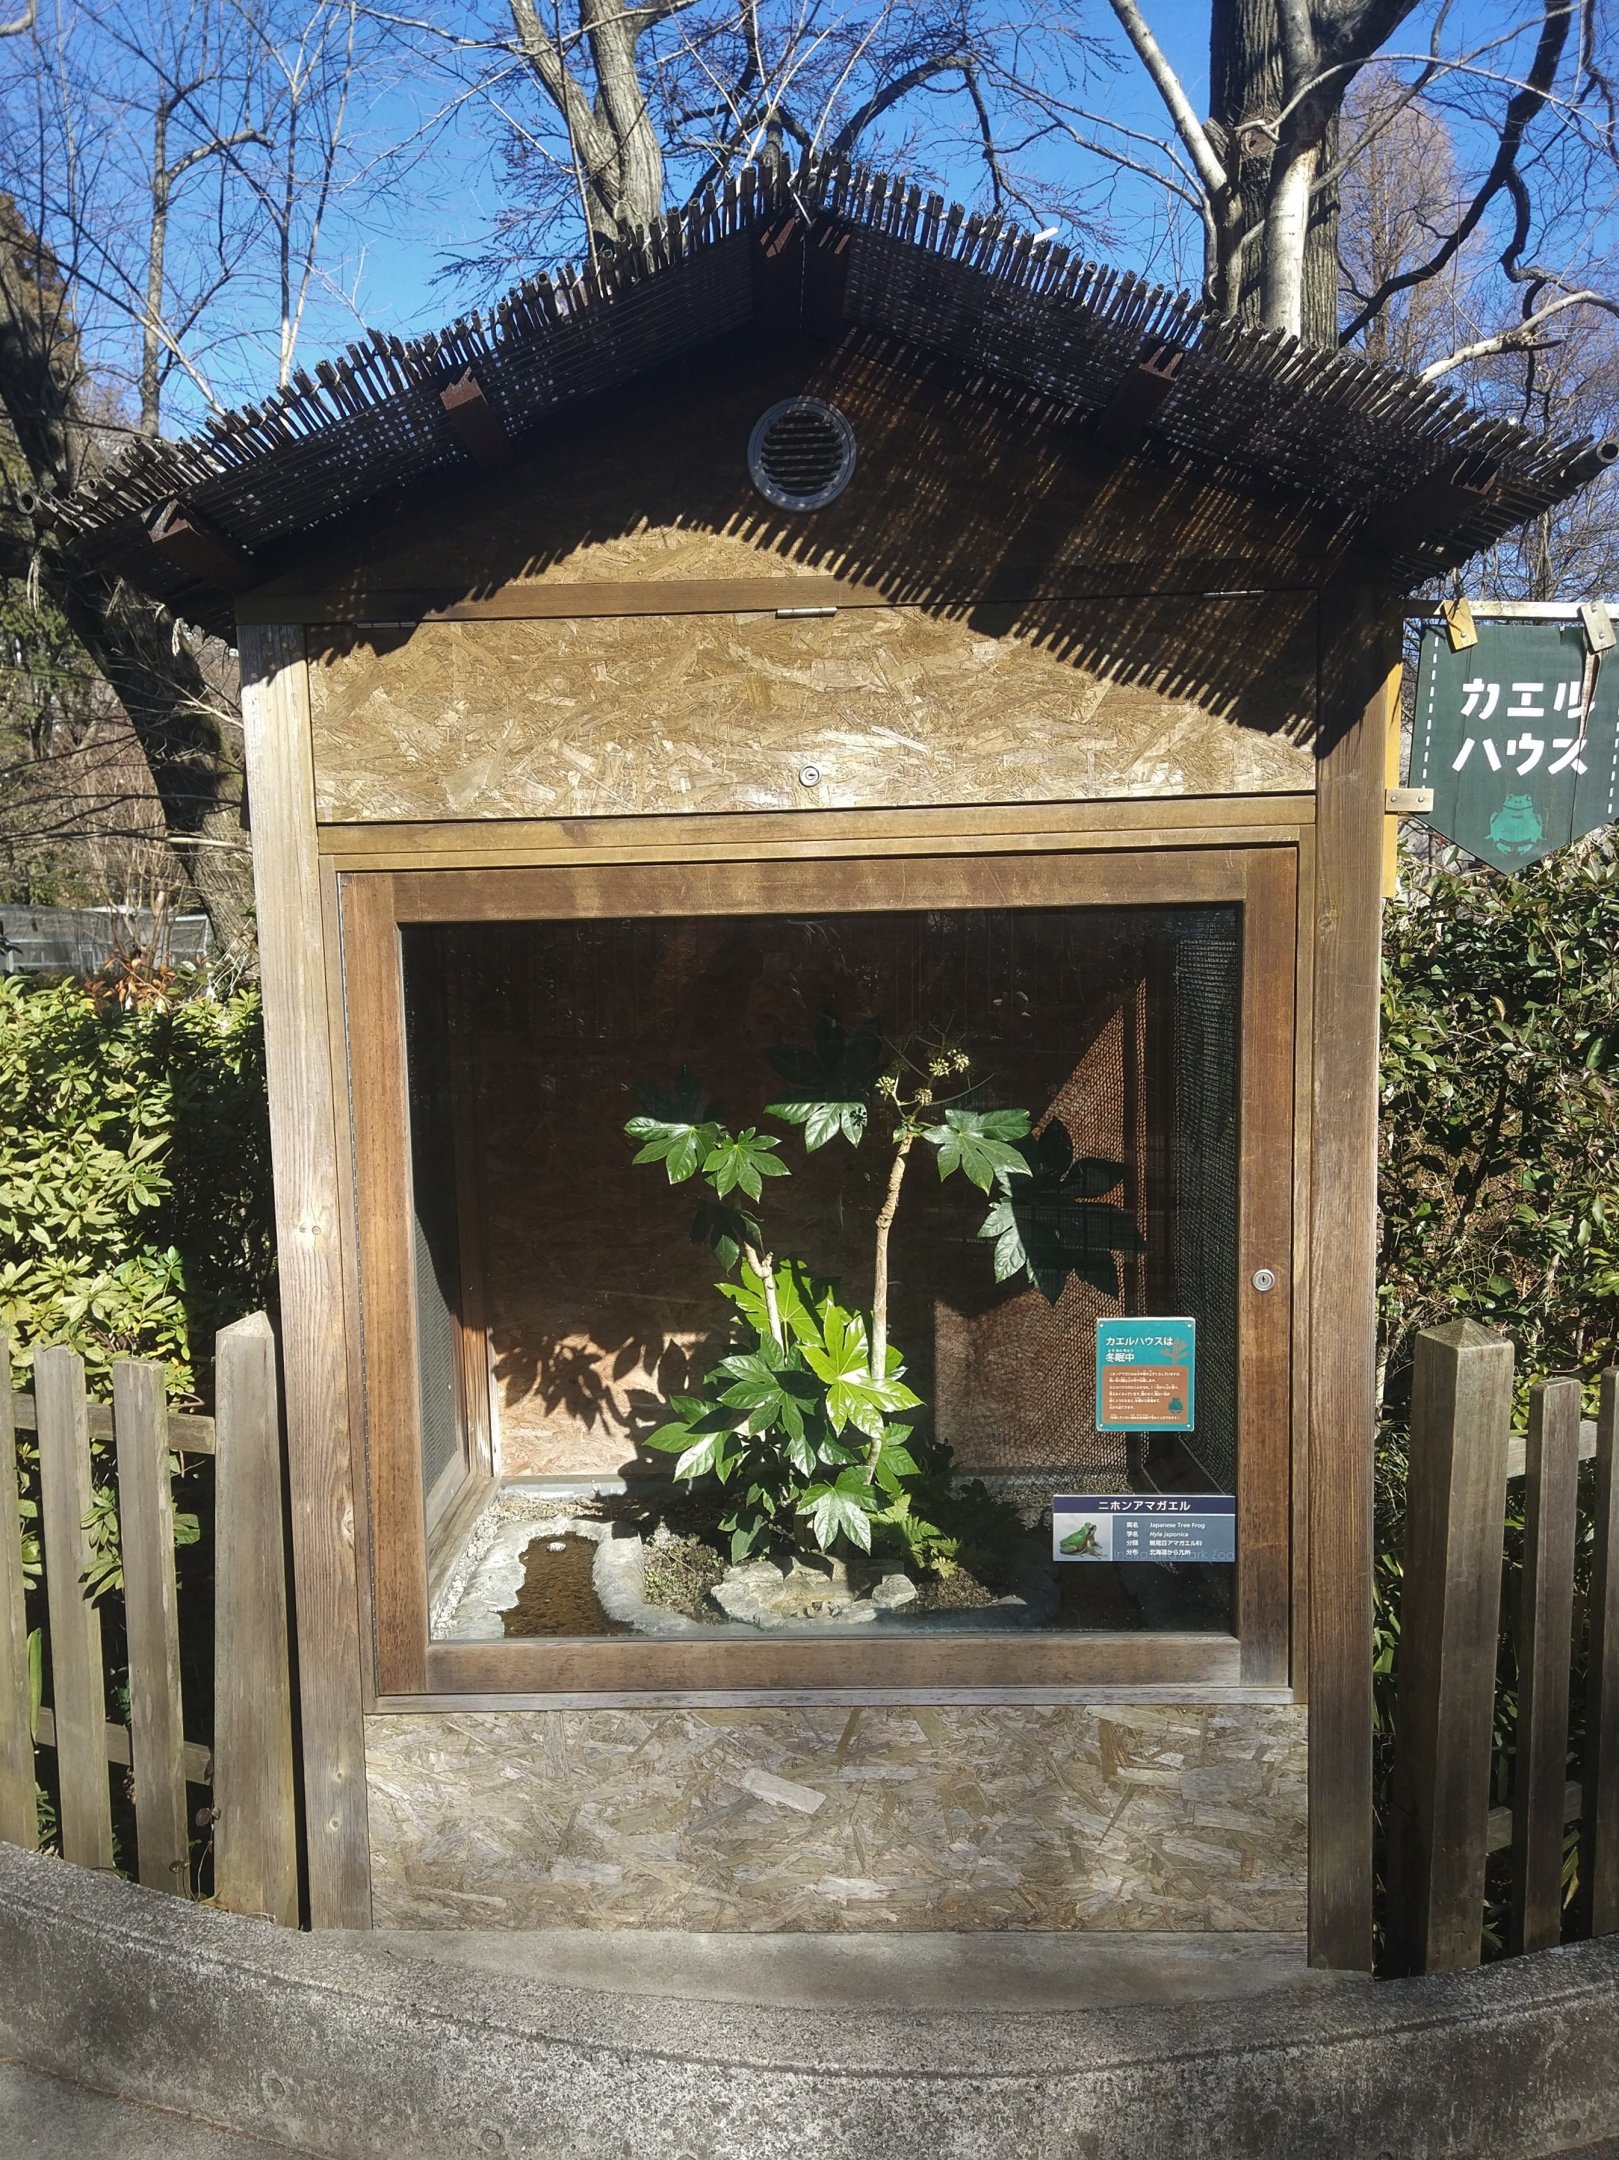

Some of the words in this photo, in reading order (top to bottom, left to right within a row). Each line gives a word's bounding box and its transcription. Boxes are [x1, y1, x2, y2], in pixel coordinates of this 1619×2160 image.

[1460, 678, 1596, 720] カエル
[1452, 732, 1589, 777] ハウス
[1106, 1336, 1173, 1346] カエルハウスは
[1105, 1352, 1135, 1362] 冬眠中
[1098, 1500, 1191, 1511] ニホンアマガエル
[1181, 1550, 1208, 1559] ark
[1211, 1550, 1235, 1559] Zoo
